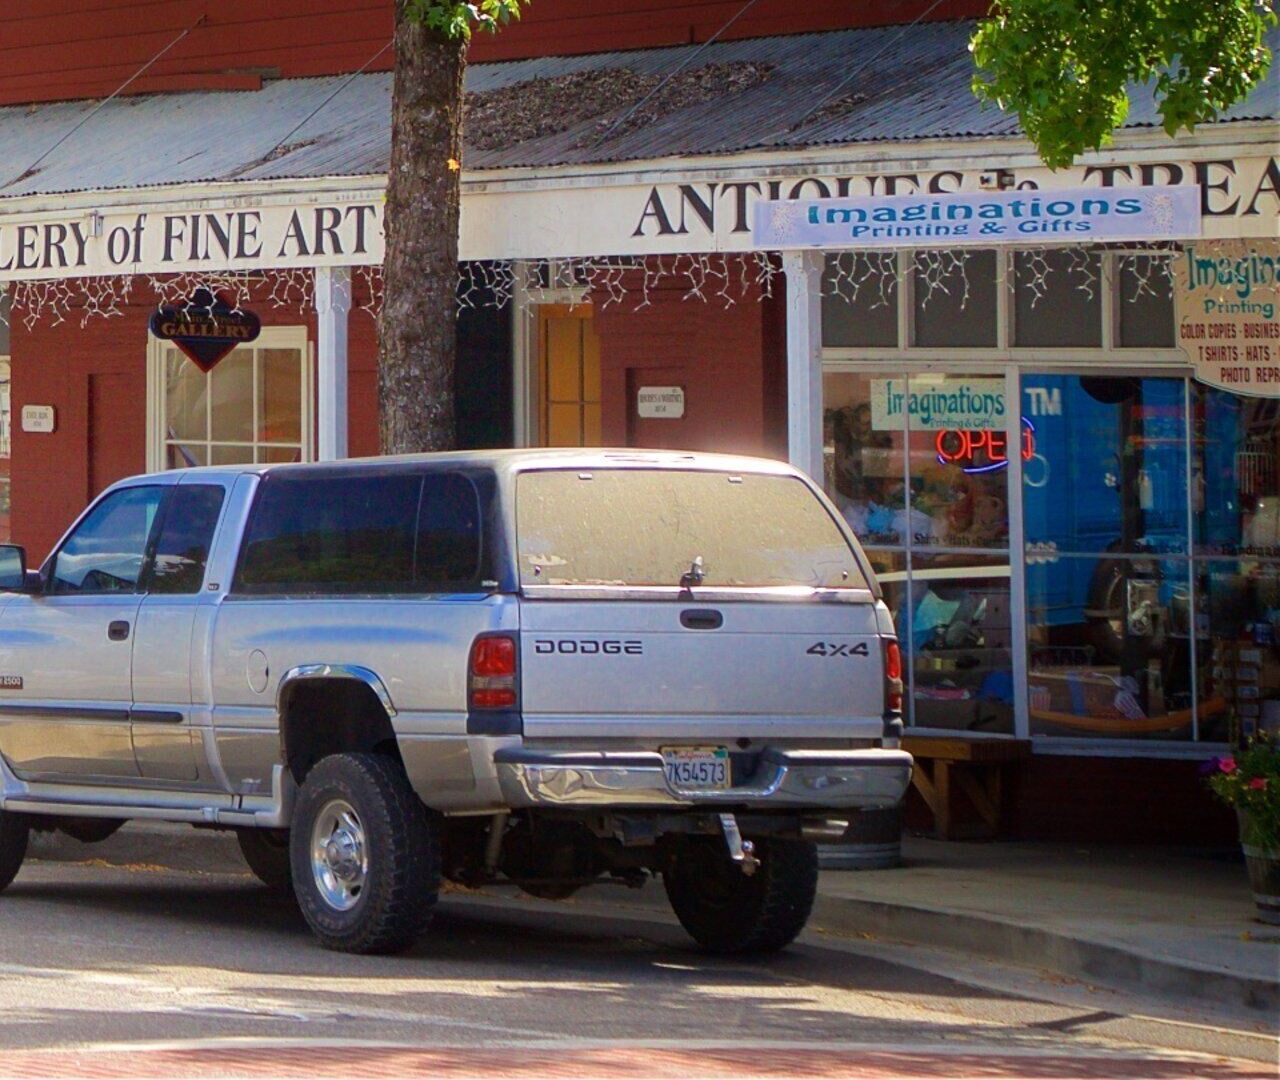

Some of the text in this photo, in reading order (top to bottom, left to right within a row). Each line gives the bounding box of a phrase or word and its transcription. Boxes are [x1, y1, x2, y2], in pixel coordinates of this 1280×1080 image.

[808, 197, 1143, 224] Imaginations
[107, 213, 148, 266] of
[161, 210, 263, 263] FINE
[277, 205, 377, 258] ART
[851, 219, 1091, 238] Printing & Gifts
[1187, 247, 1280, 298] Imagin
[1204, 299, 1274, 319] Printing
[161, 322, 252, 337] GALLERY
[1180, 323, 1206, 339] COLOR
[1208, 323, 1236, 339] COPIES
[1205, 345, 1238, 361] SHIRTS
[1246, 345, 1271, 361] HATS
[1220, 367, 1250, 382] PHOTO
[887, 381, 1004, 424] Imaginations
[535, 640, 643, 654] DODGE
[666, 761, 725, 785] 7K54573
